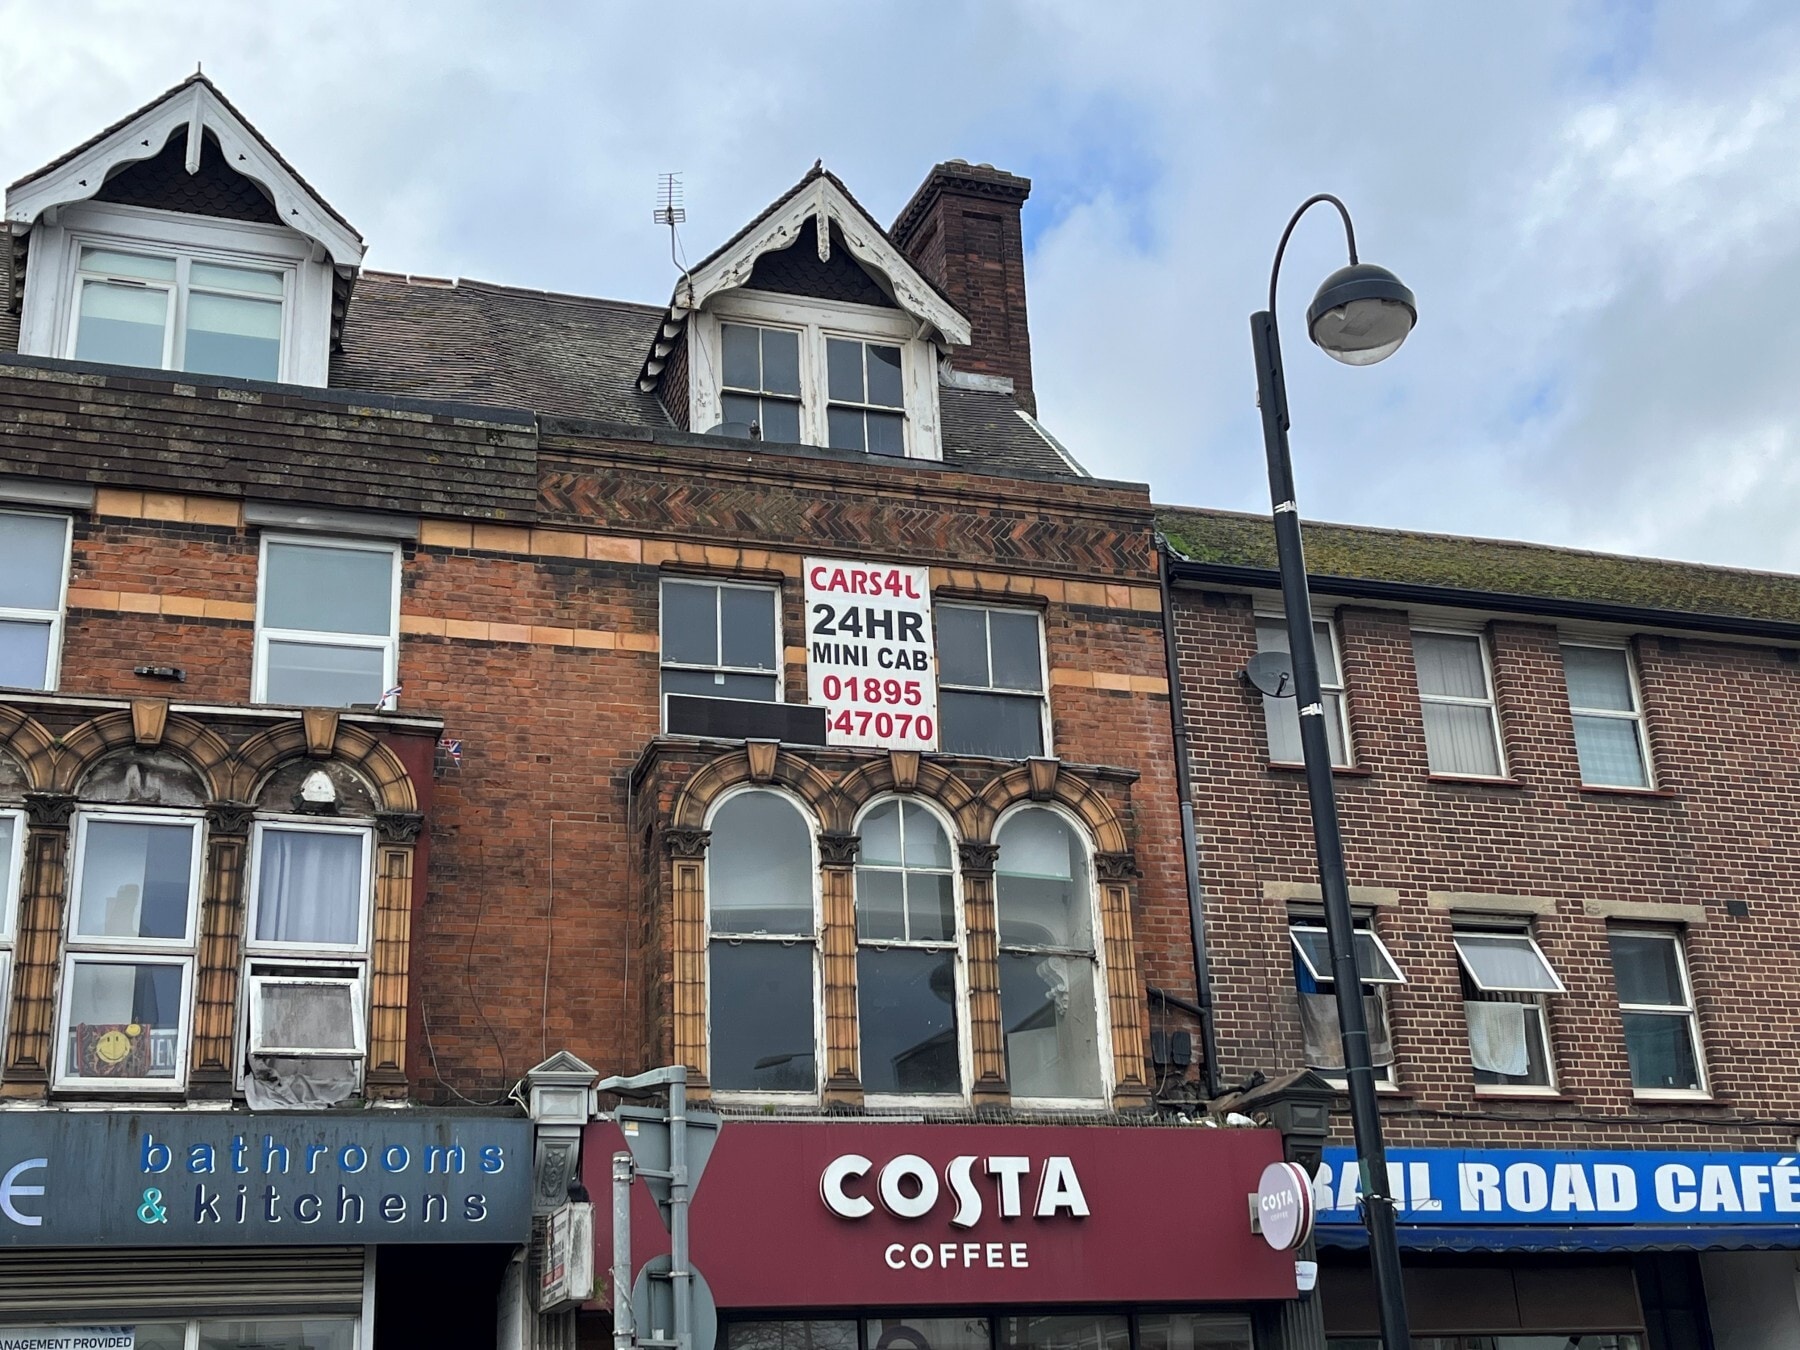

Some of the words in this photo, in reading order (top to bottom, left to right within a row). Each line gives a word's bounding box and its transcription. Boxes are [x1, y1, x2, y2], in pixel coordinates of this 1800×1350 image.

[812, 603, 926, 643] 24HR
[812, 641, 868, 667] MINI
[877, 647, 928, 671] CAB
[822, 675, 922, 706] 01895
[140, 1132, 504, 1174] bathrooms
[819, 1154, 1091, 1229] COSTA
[1262, 1189, 1294, 1211] COSTA
[1458, 1162, 1638, 1212] ROAD
[1654, 1157, 1800, 1213] CAFÉ
[136, 1187, 168, 1224] &
[193, 1183, 487, 1224] kitchens
[884, 1243, 1029, 1269] COFFEE
[73, 1337, 132, 1349] PROVIDED
